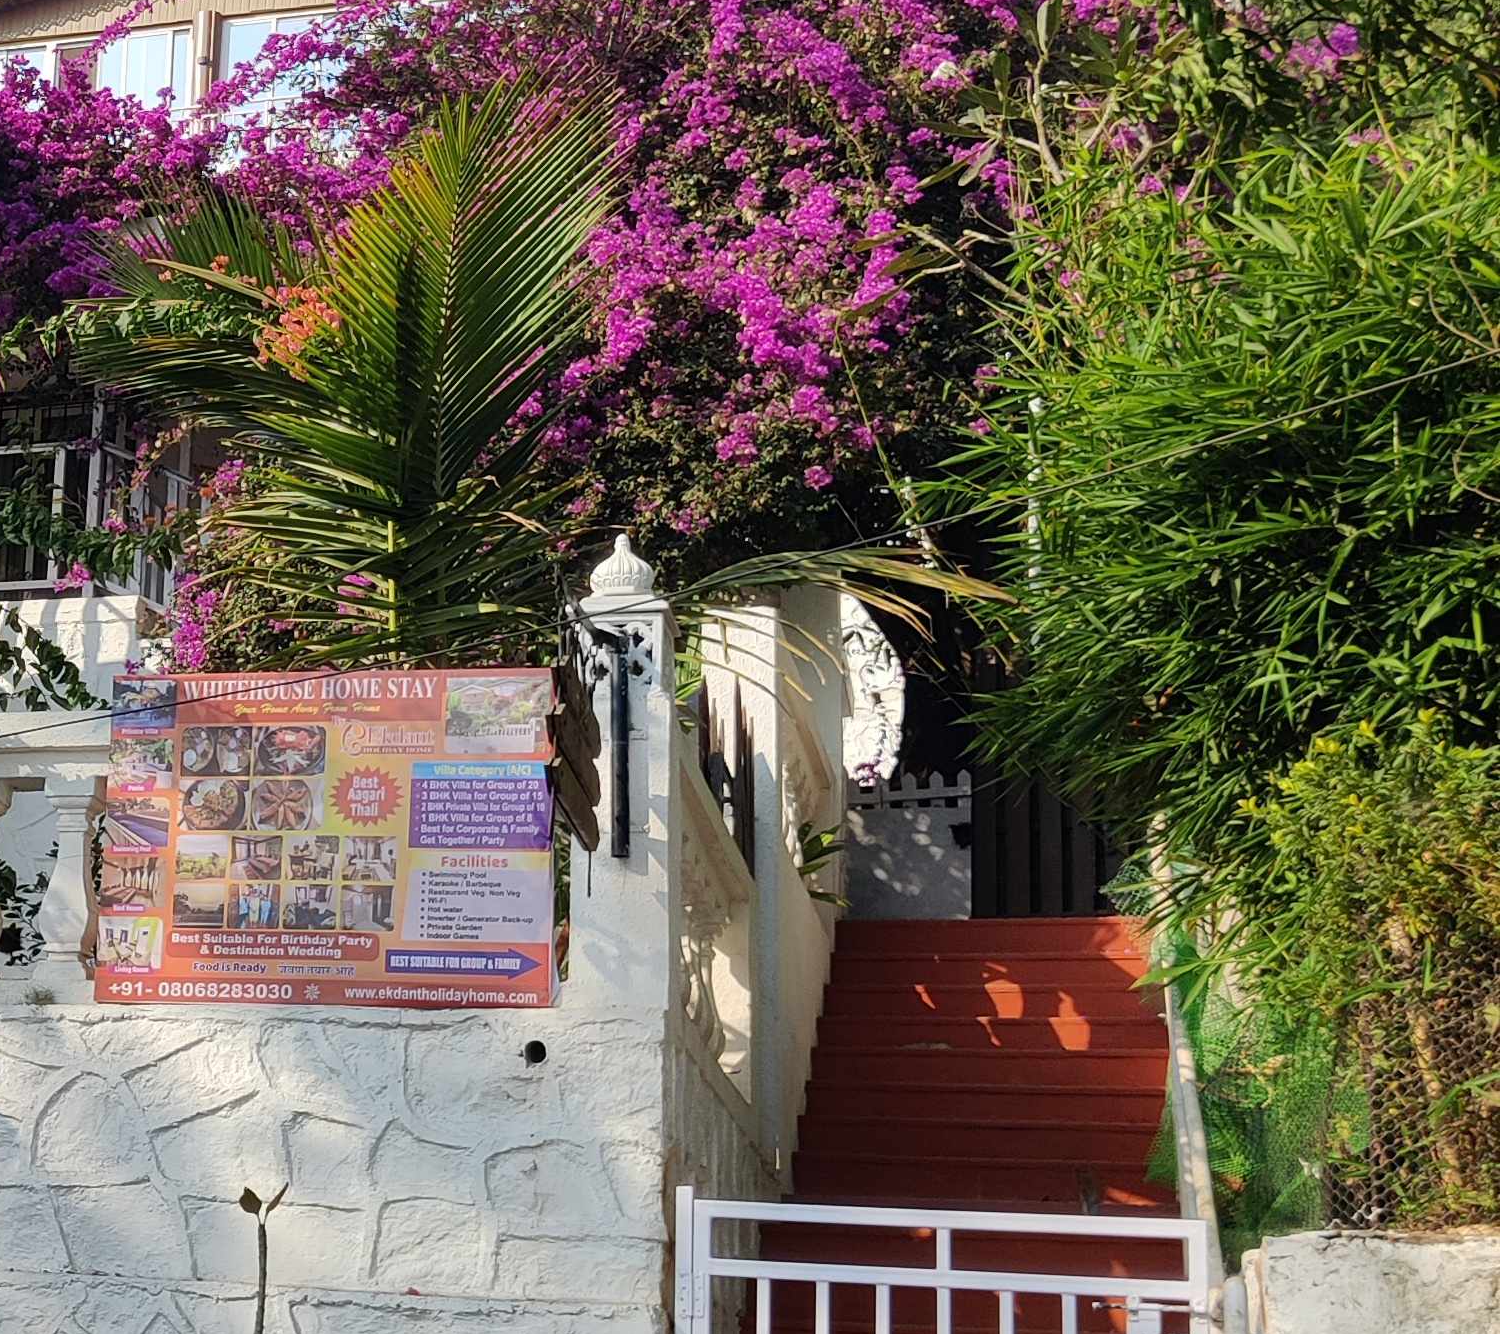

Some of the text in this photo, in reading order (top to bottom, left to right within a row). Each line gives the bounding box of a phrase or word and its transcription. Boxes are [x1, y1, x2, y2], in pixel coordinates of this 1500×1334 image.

[183, 676, 438, 701] WHITEHOUSE HOME STAY
[353, 775, 380, 788] Best
[429, 780, 450, 789] BHK
[451, 780, 470, 789] Villa
[472, 780, 485, 789] for
[486, 780, 515, 790] Group
[516, 780, 527, 789] of
[528, 780, 539, 789] 20
[347, 786, 385, 804] Aagari
[429, 791, 450, 800] BHK
[452, 791, 472, 800] Villa
[474, 791, 487, 800] for
[489, 791, 518, 802] Group
[519, 791, 530, 800] of
[532, 791, 543, 800] 15
[349, 802, 378, 816] Thali
[428, 802, 444, 811] BHK
[445, 802, 471, 811] Private
[473, 802, 488, 811] Villa
[490, 802, 500, 811] for
[501, 802, 525, 813] Group
[526, 802, 535, 811] of
[536, 802, 545, 811] 10
[429, 813, 449, 822] BHK
[451, 813, 469, 822] Villa
[471, 813, 484, 822] for
[486, 813, 514, 823] Group
[516, 813, 526, 822] of
[420, 824, 440, 833] Best
[442, 824, 455, 833] for
[456, 824, 498, 835] Corporate
[510, 824, 539, 835] Family
[420, 836, 436, 844] Get
[438, 836, 475, 845] Together
[482, 836, 505, 845] Party
[441, 855, 509, 868] Facilities
[171, 932, 373, 948] Best Suitable For Birthday Party
[426, 932, 479, 940] Indoor Games
[200, 944, 342, 959] & Destination Wedding
[193, 962, 220, 972] Food
[233, 962, 267, 975] Ready
[390, 955, 521, 970] BEST SUITABLE FOR GROUP & FAMILY
[108, 981, 293, 1000] +91- 08068283030
[344, 986, 539, 1005] www.ekdantholidayhome.com
